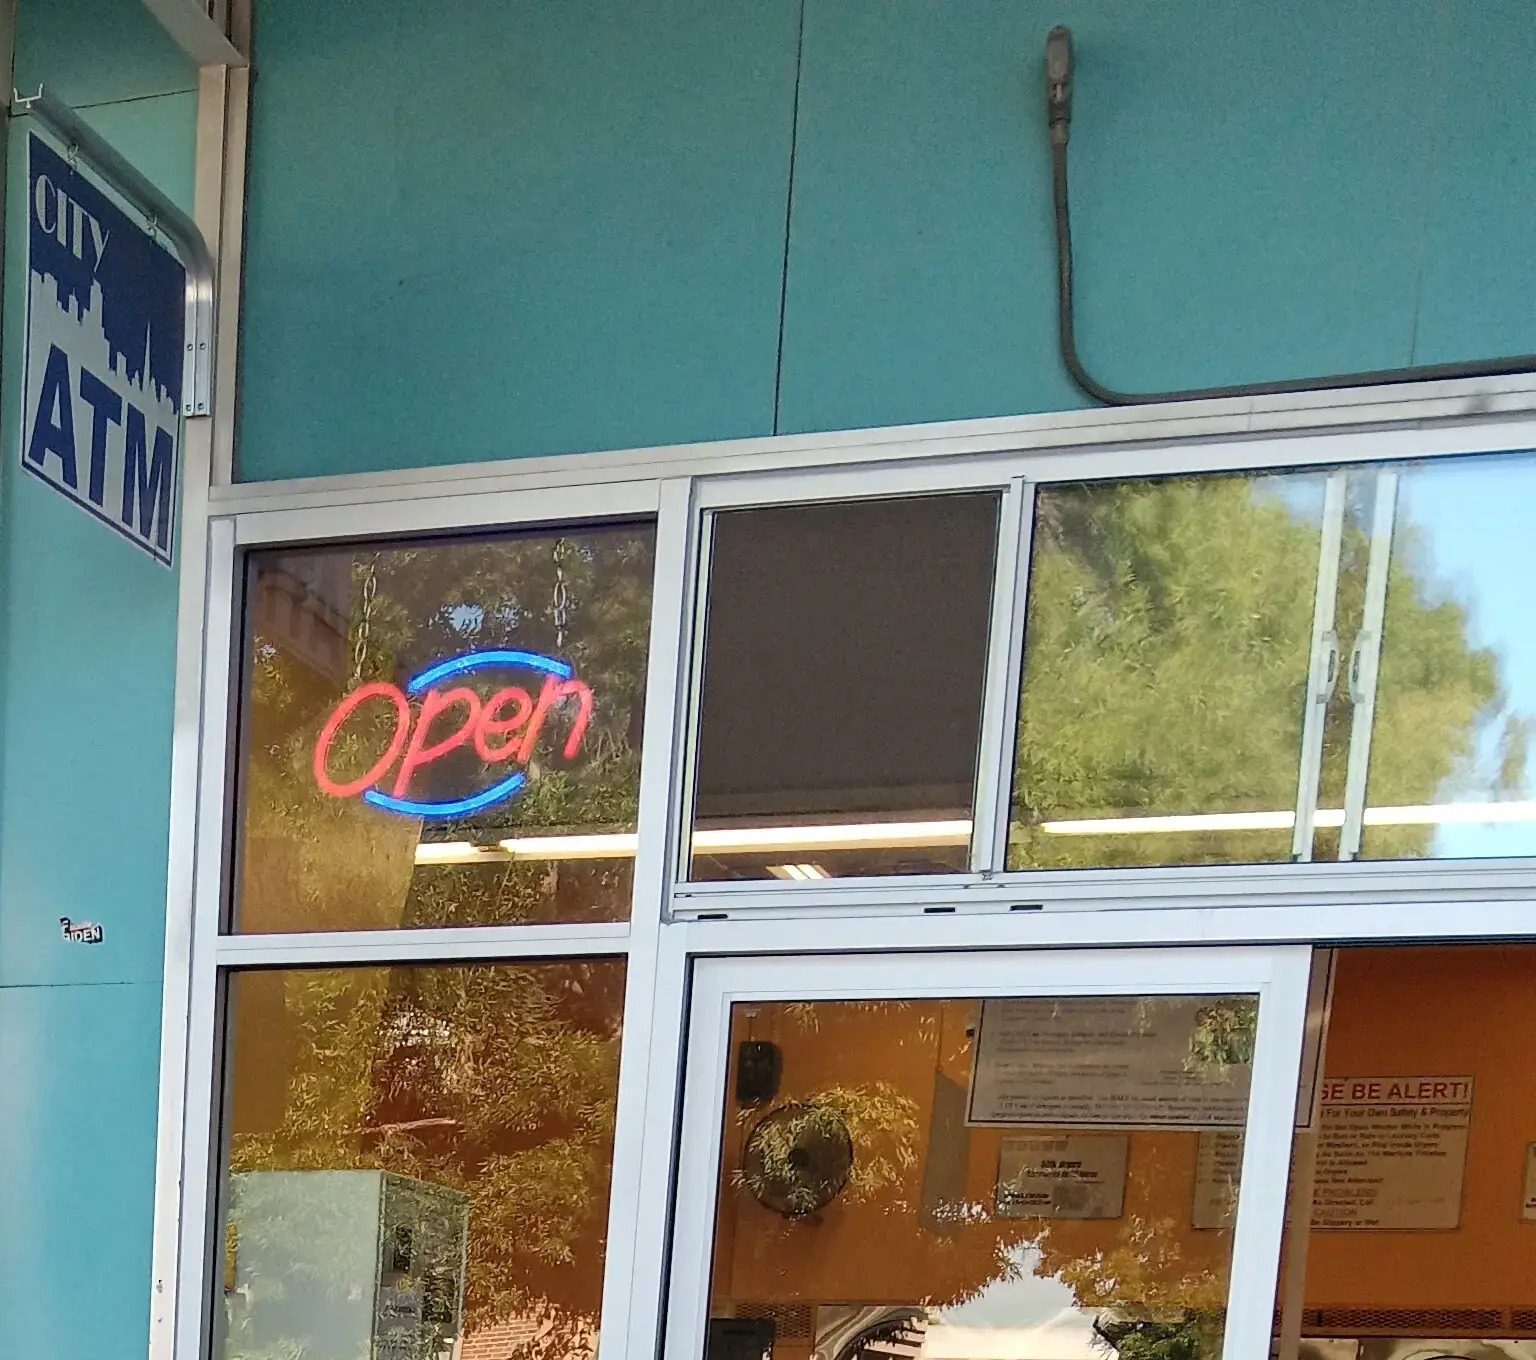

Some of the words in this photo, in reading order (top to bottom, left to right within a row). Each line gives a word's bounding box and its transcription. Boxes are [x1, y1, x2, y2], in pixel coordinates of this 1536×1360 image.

[35, 174, 110, 273] CITY
[28, 343, 173, 552] ATM
[314, 674, 595, 799] Open
[1326, 1109, 1343, 1118] For
[1345, 1108, 1366, 1118] Your
[1368, 1107, 1388, 1117] Own
[1351, 1082, 1381, 1100] BE
[1386, 1081, 1468, 1099] ALERT!
